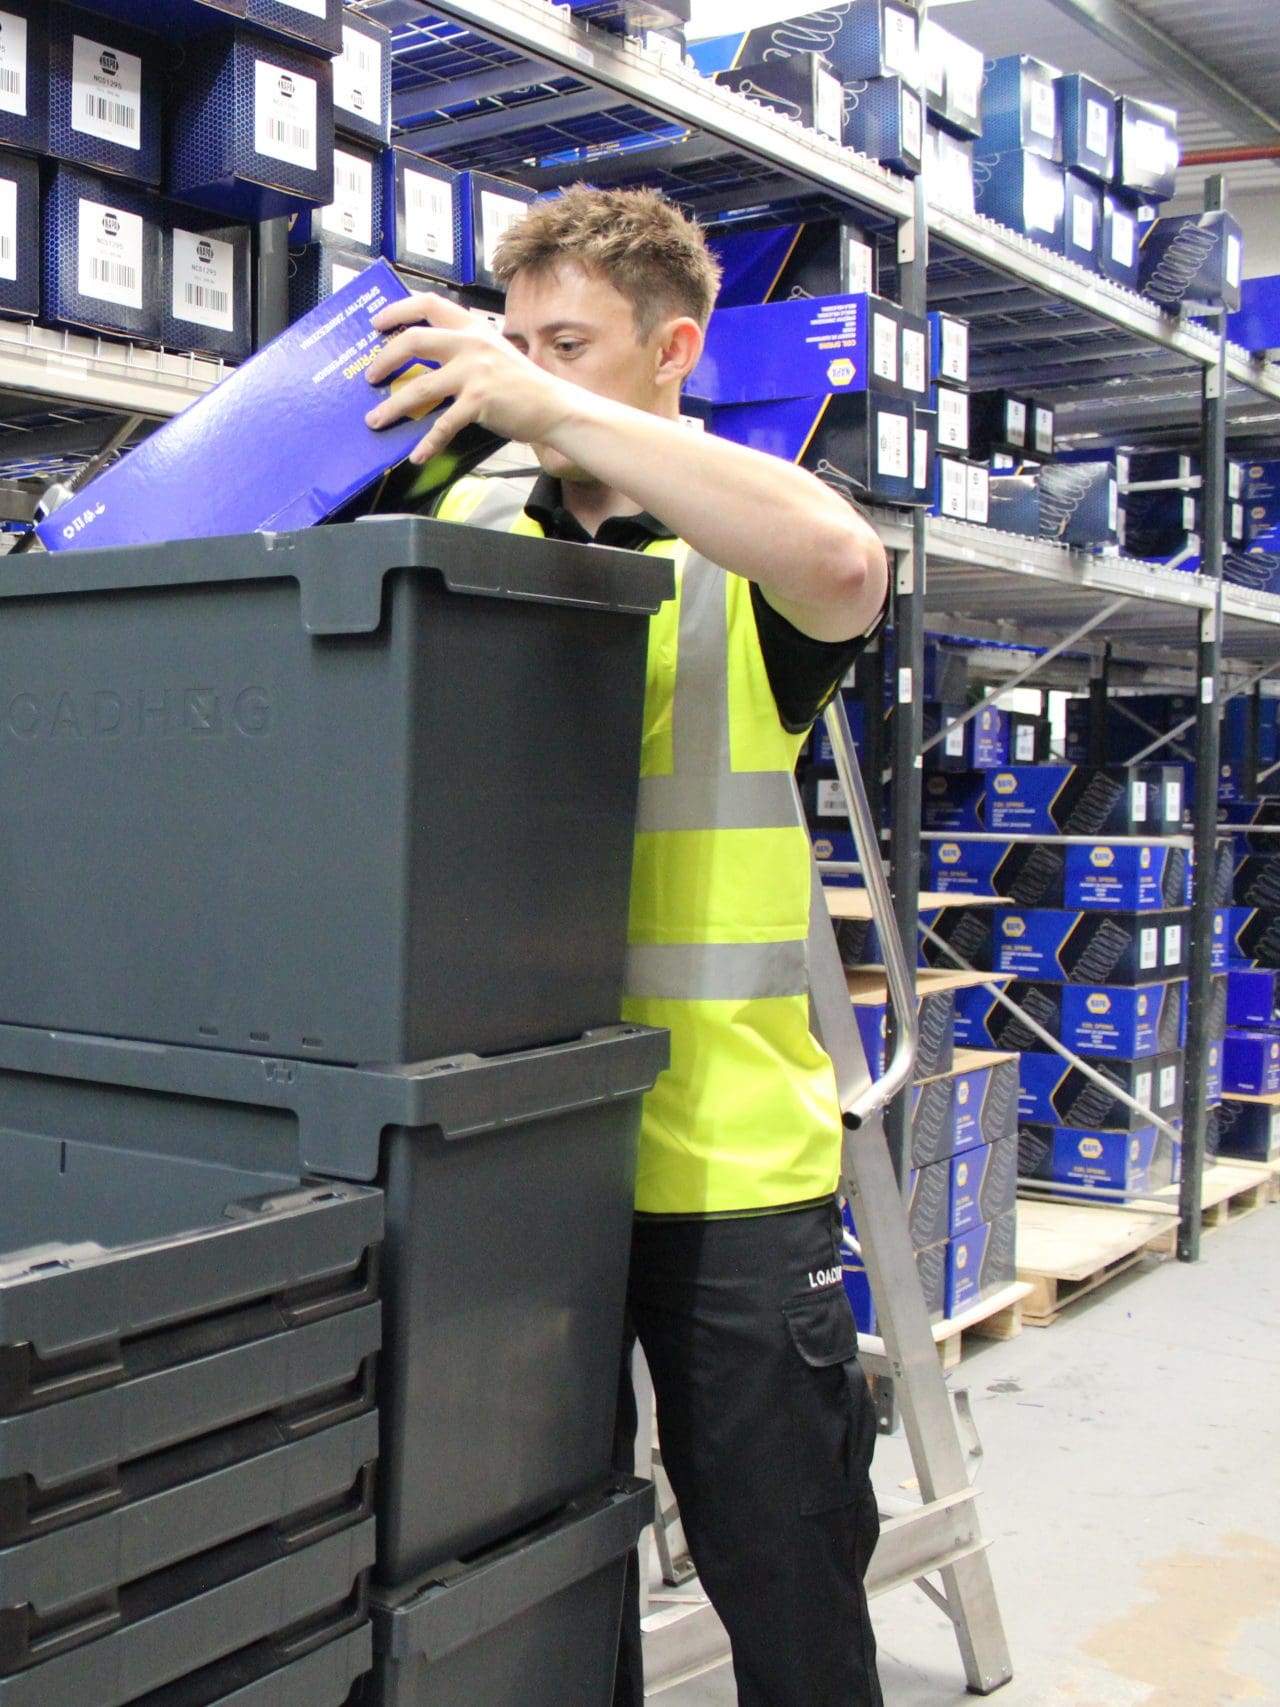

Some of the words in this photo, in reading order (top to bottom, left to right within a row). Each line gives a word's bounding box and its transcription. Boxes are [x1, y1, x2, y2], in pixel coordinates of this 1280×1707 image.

[103, 57, 116, 70] NAPA
[94, 75, 122, 88] NCS1295
[199, 247, 212, 258] NAPA
